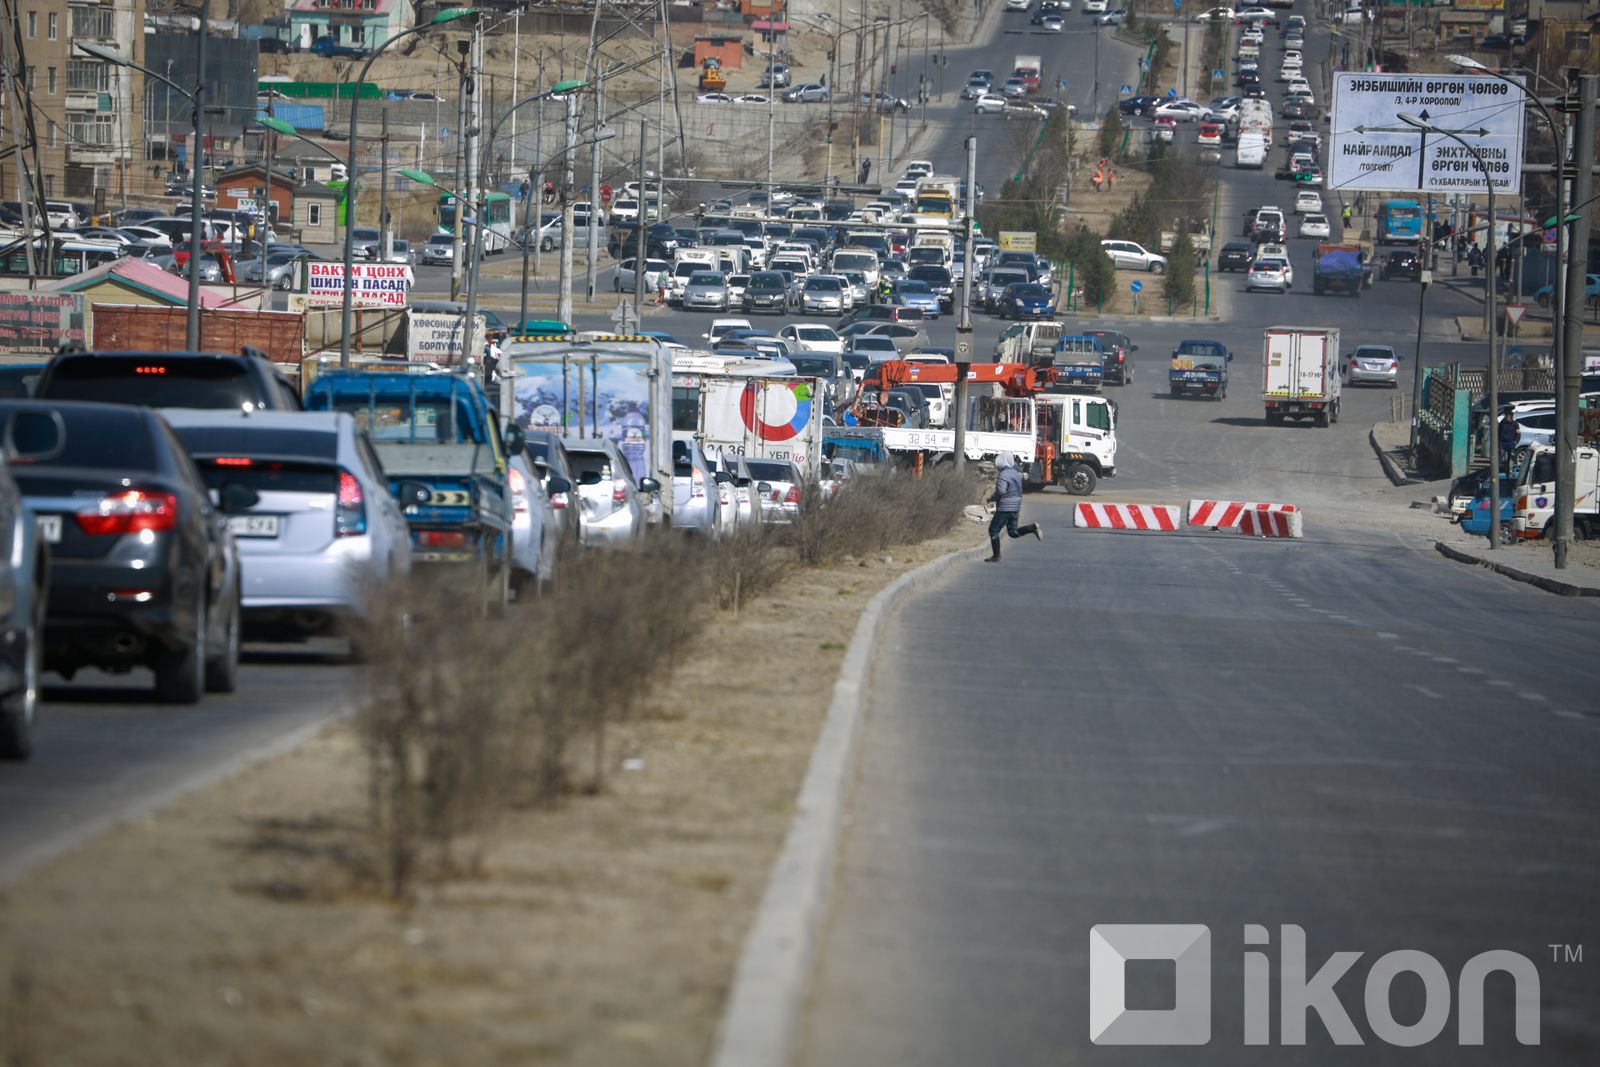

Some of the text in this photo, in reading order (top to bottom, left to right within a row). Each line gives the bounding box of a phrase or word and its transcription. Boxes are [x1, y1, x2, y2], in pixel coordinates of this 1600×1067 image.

[1350, 78, 1508, 95] ЭНЭБИШИЙН ӨРГӨН ЧӨЛӨӨ
[1343, 141, 1412, 158] НАЙРАМДАЛ
[1432, 160, 1469, 172] ӨРГӨН
[367, 267, 405, 279] ЦОНХ
[311, 277, 405, 292] ШИЛН ПАСАД
[769, 450, 789, 460] УБЛ
